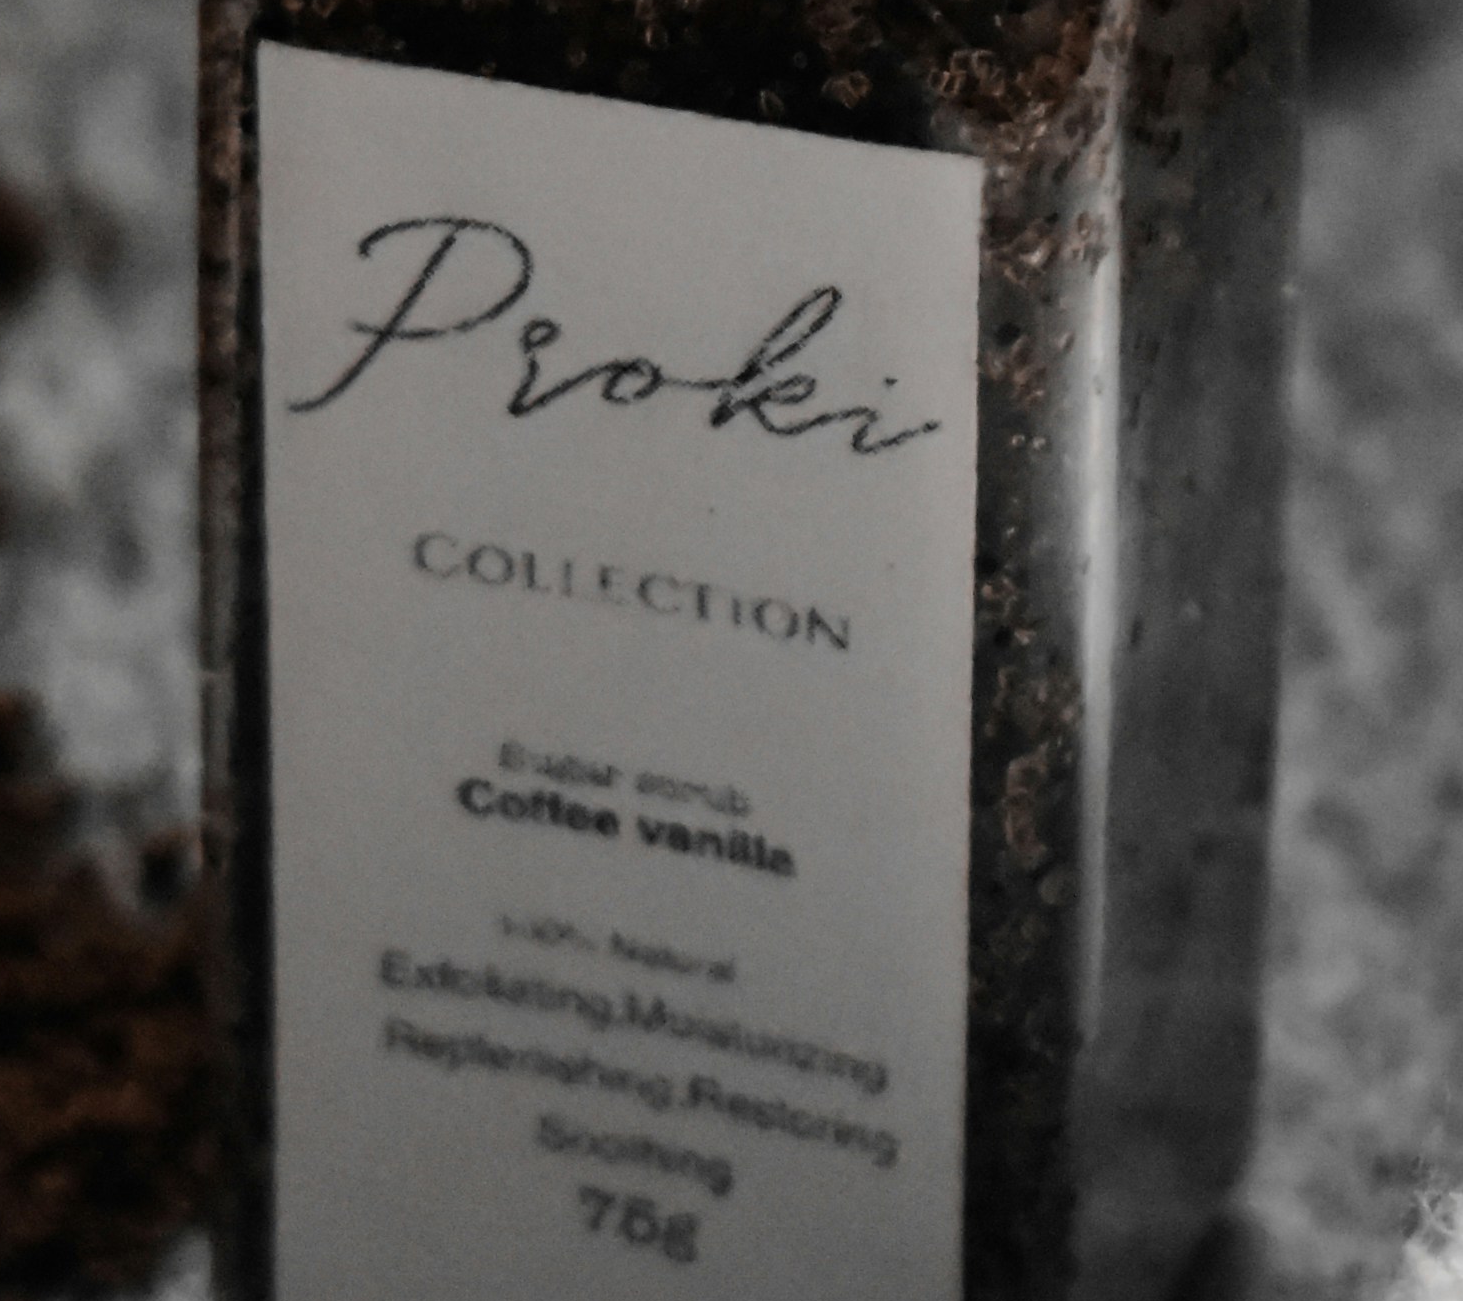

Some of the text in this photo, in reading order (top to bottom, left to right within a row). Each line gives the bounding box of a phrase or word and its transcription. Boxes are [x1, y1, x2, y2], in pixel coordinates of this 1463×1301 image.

[285, 215, 943, 456] Proki
[410, 530, 852, 652] COLLECTION
[455, 776, 796, 877] Coffee vanilla
